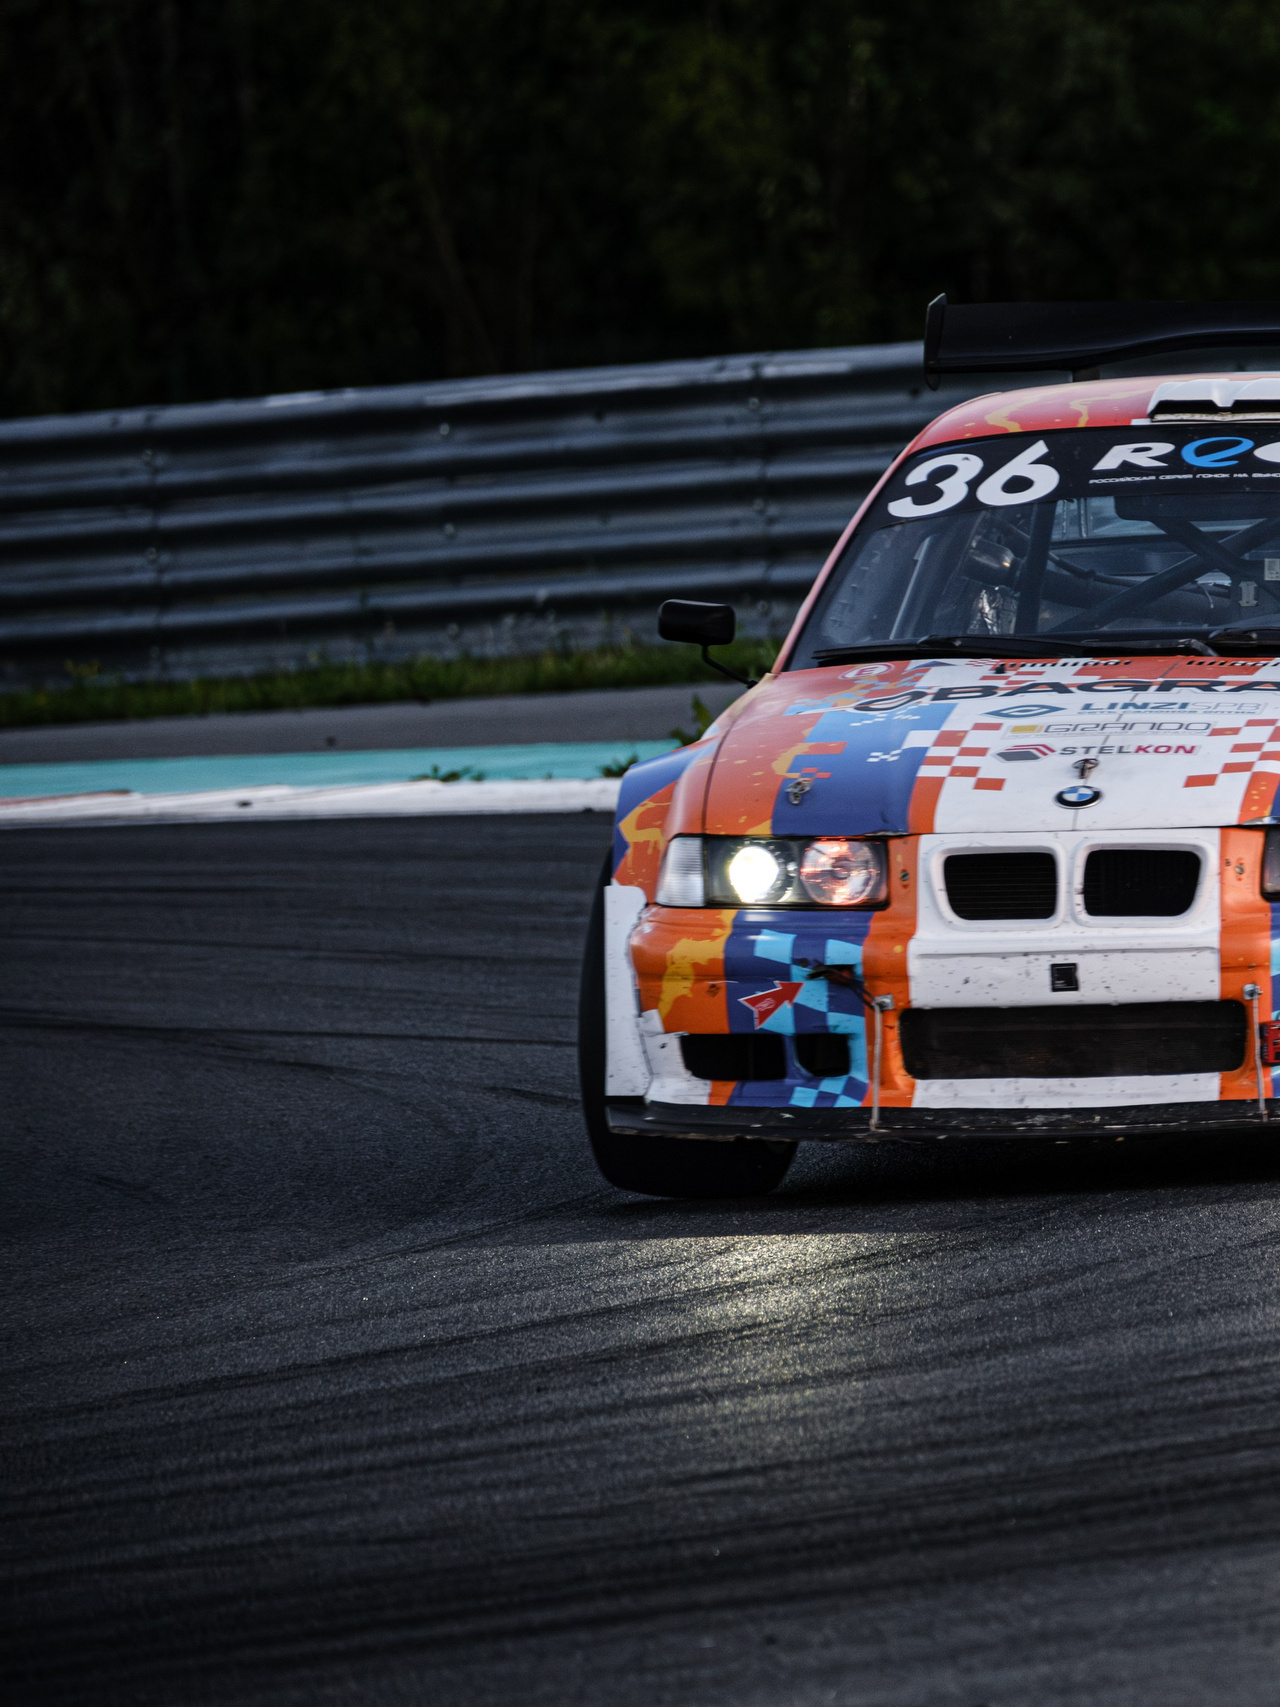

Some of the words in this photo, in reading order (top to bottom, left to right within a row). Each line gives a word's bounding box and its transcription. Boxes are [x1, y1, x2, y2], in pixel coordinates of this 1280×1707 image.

[888, 440, 1060, 518] 36
[1044, 721, 1212, 733] GRANDO
[1059, 744, 1197, 755] STELKON
